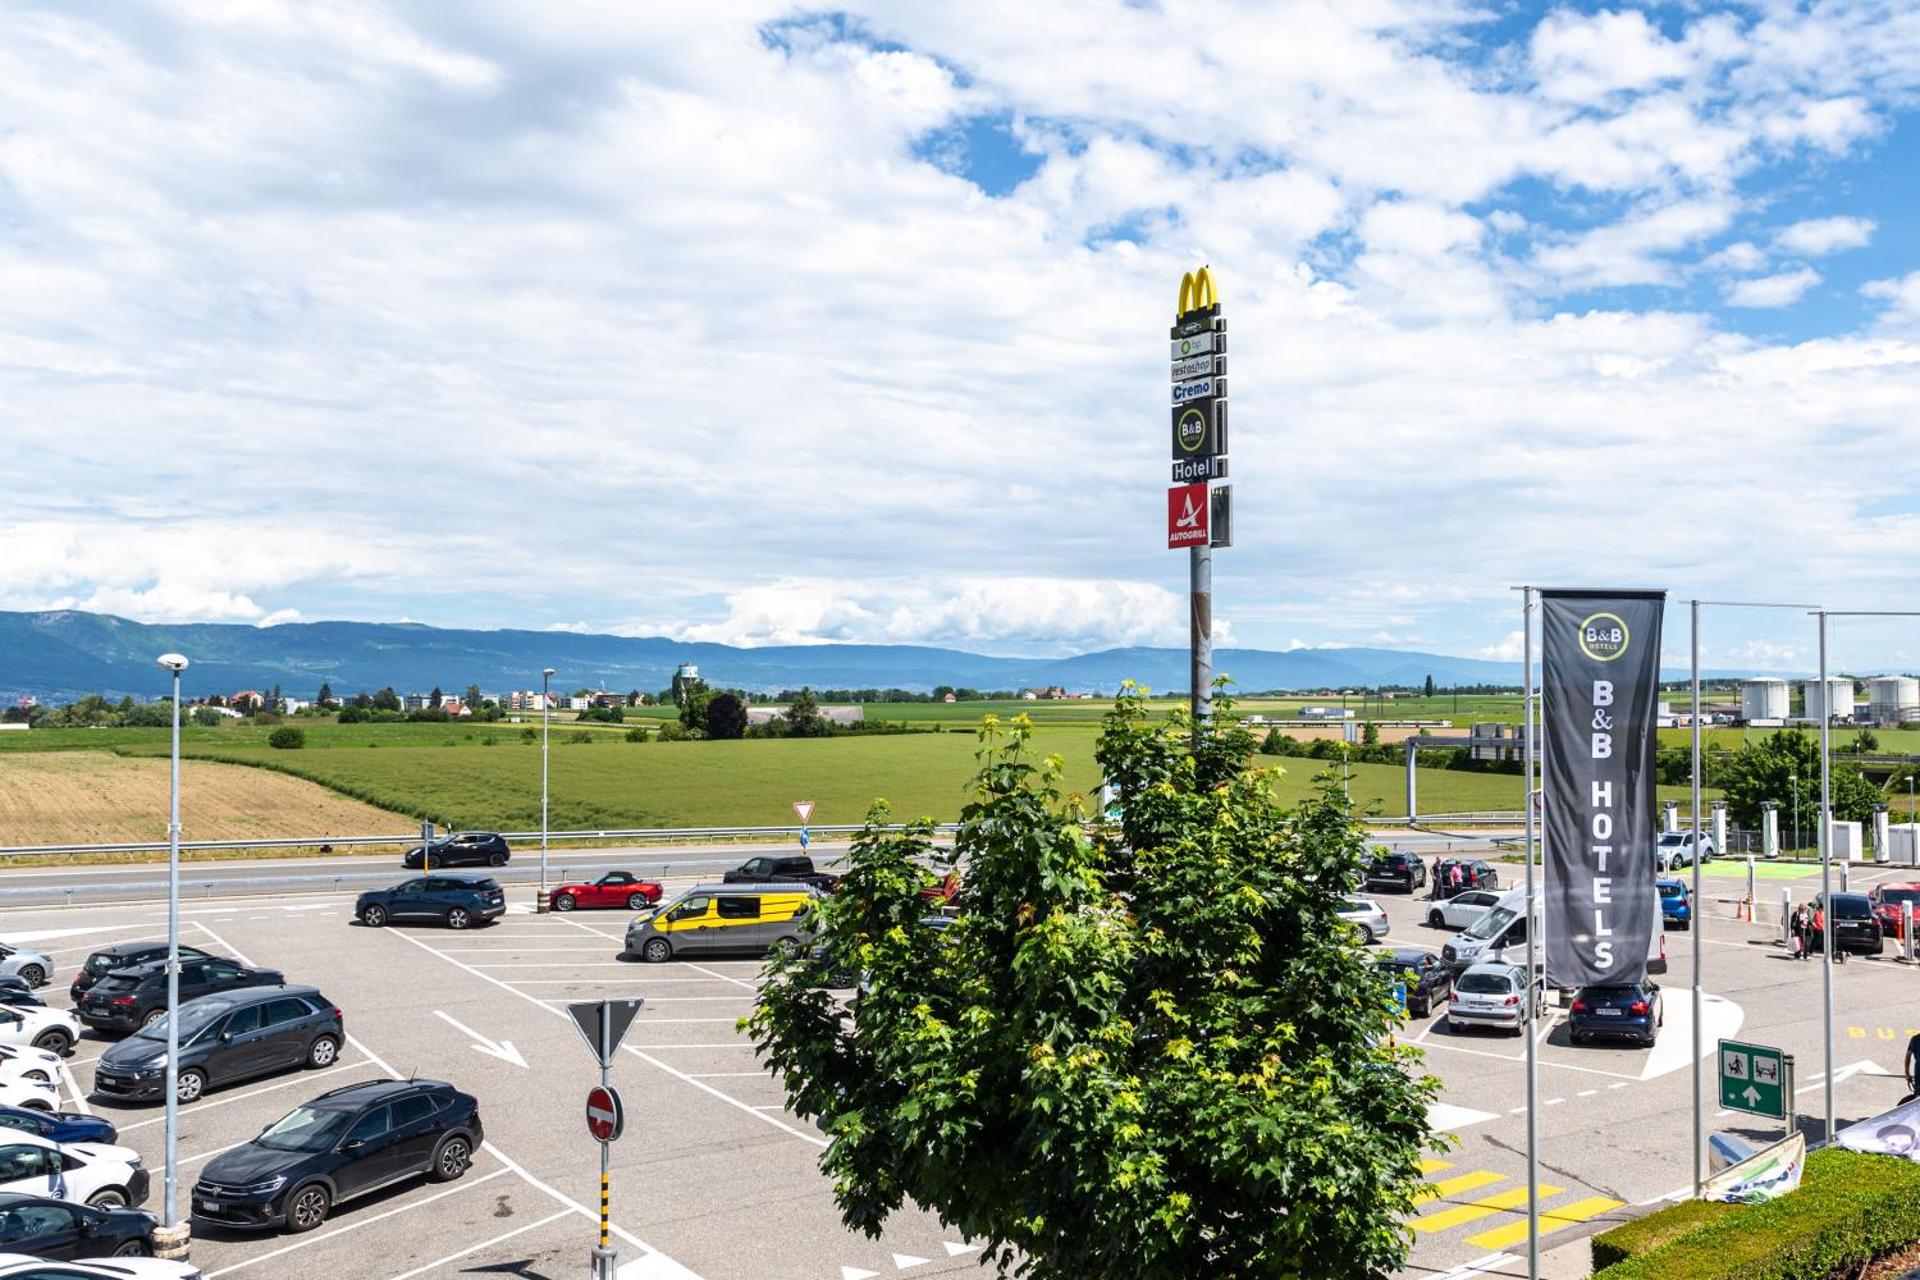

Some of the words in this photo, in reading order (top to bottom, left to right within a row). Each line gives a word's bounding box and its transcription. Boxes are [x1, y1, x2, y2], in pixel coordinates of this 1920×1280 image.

[1173, 382, 1210, 399] Cremo
[1182, 420, 1202, 437] B&B
[1174, 458, 1210, 480] Hotel
[1169, 529, 1207, 542] AUTOGRILL
[1586, 627, 1622, 642] B&B
[1591, 680, 1614, 759] B&B
[1591, 781, 1614, 969] HOTELS
